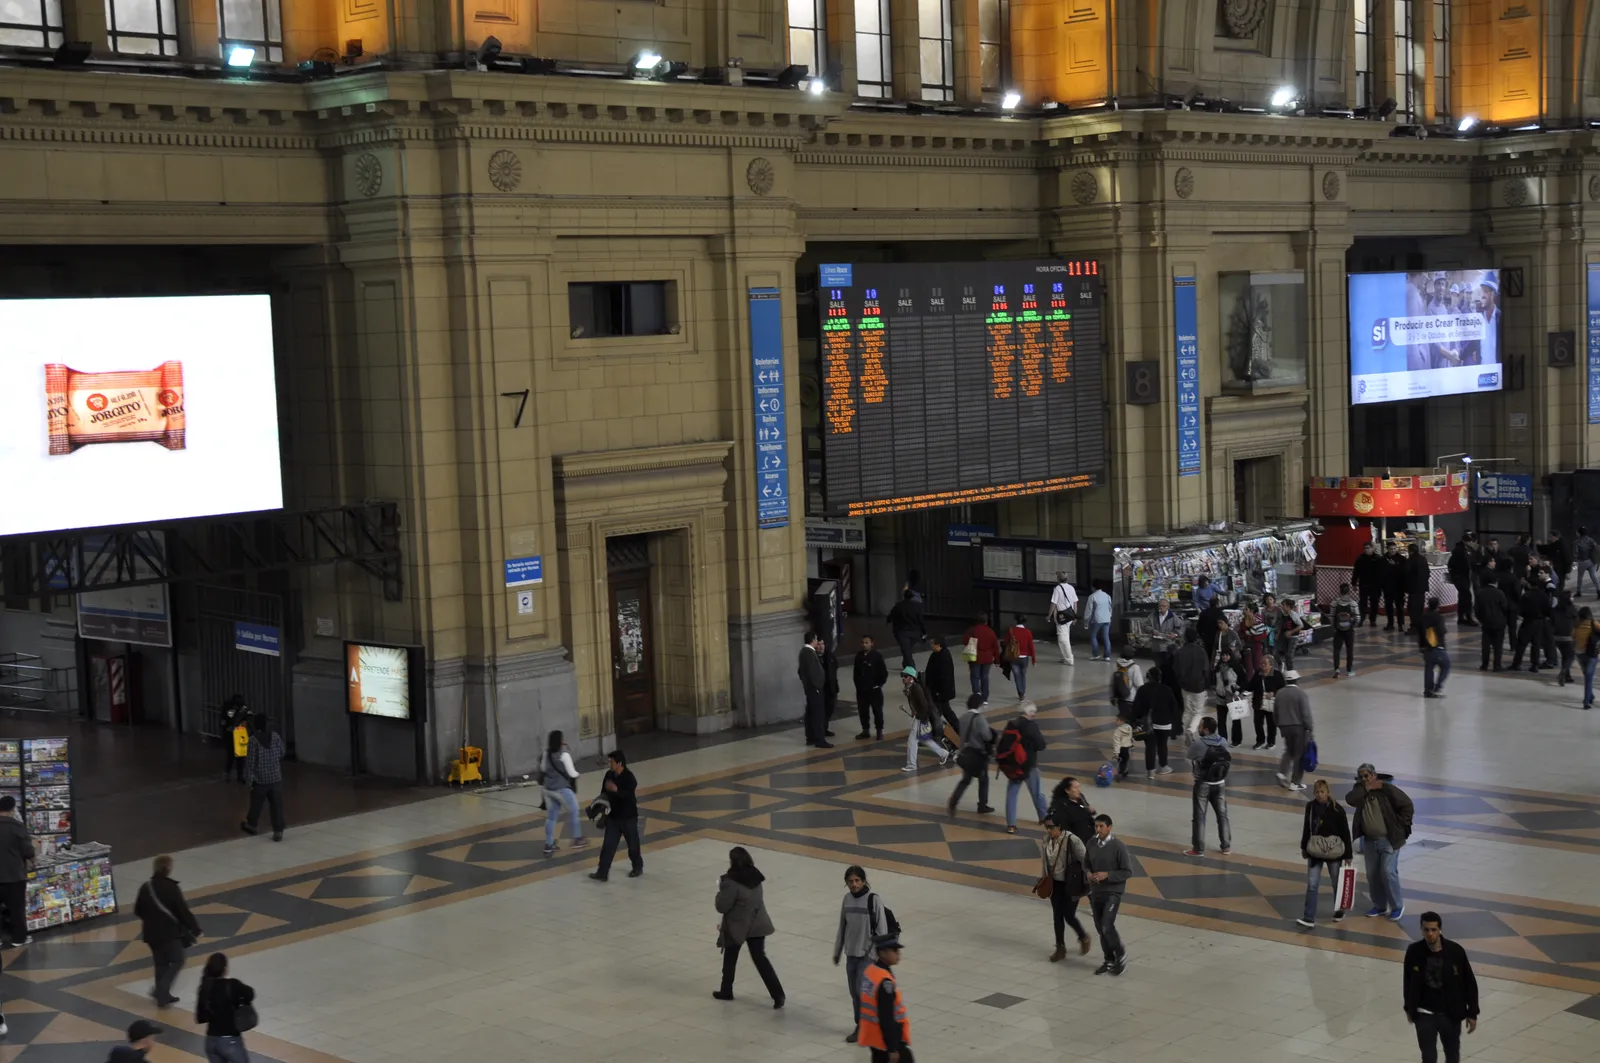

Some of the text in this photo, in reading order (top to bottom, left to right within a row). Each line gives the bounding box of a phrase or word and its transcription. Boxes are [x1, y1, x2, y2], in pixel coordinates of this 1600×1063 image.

[831, 290, 842, 300] 11
[866, 288, 877, 299] 10
[1395, 321, 1424, 330] Producir
[1435, 319, 1453, 327] Crear
[1456, 318, 1482, 327] Trabajo.
[1554, 337, 1568, 360] 6
[1135, 368, 1150, 396] 8
[90, 402, 141, 423] JORGITO
